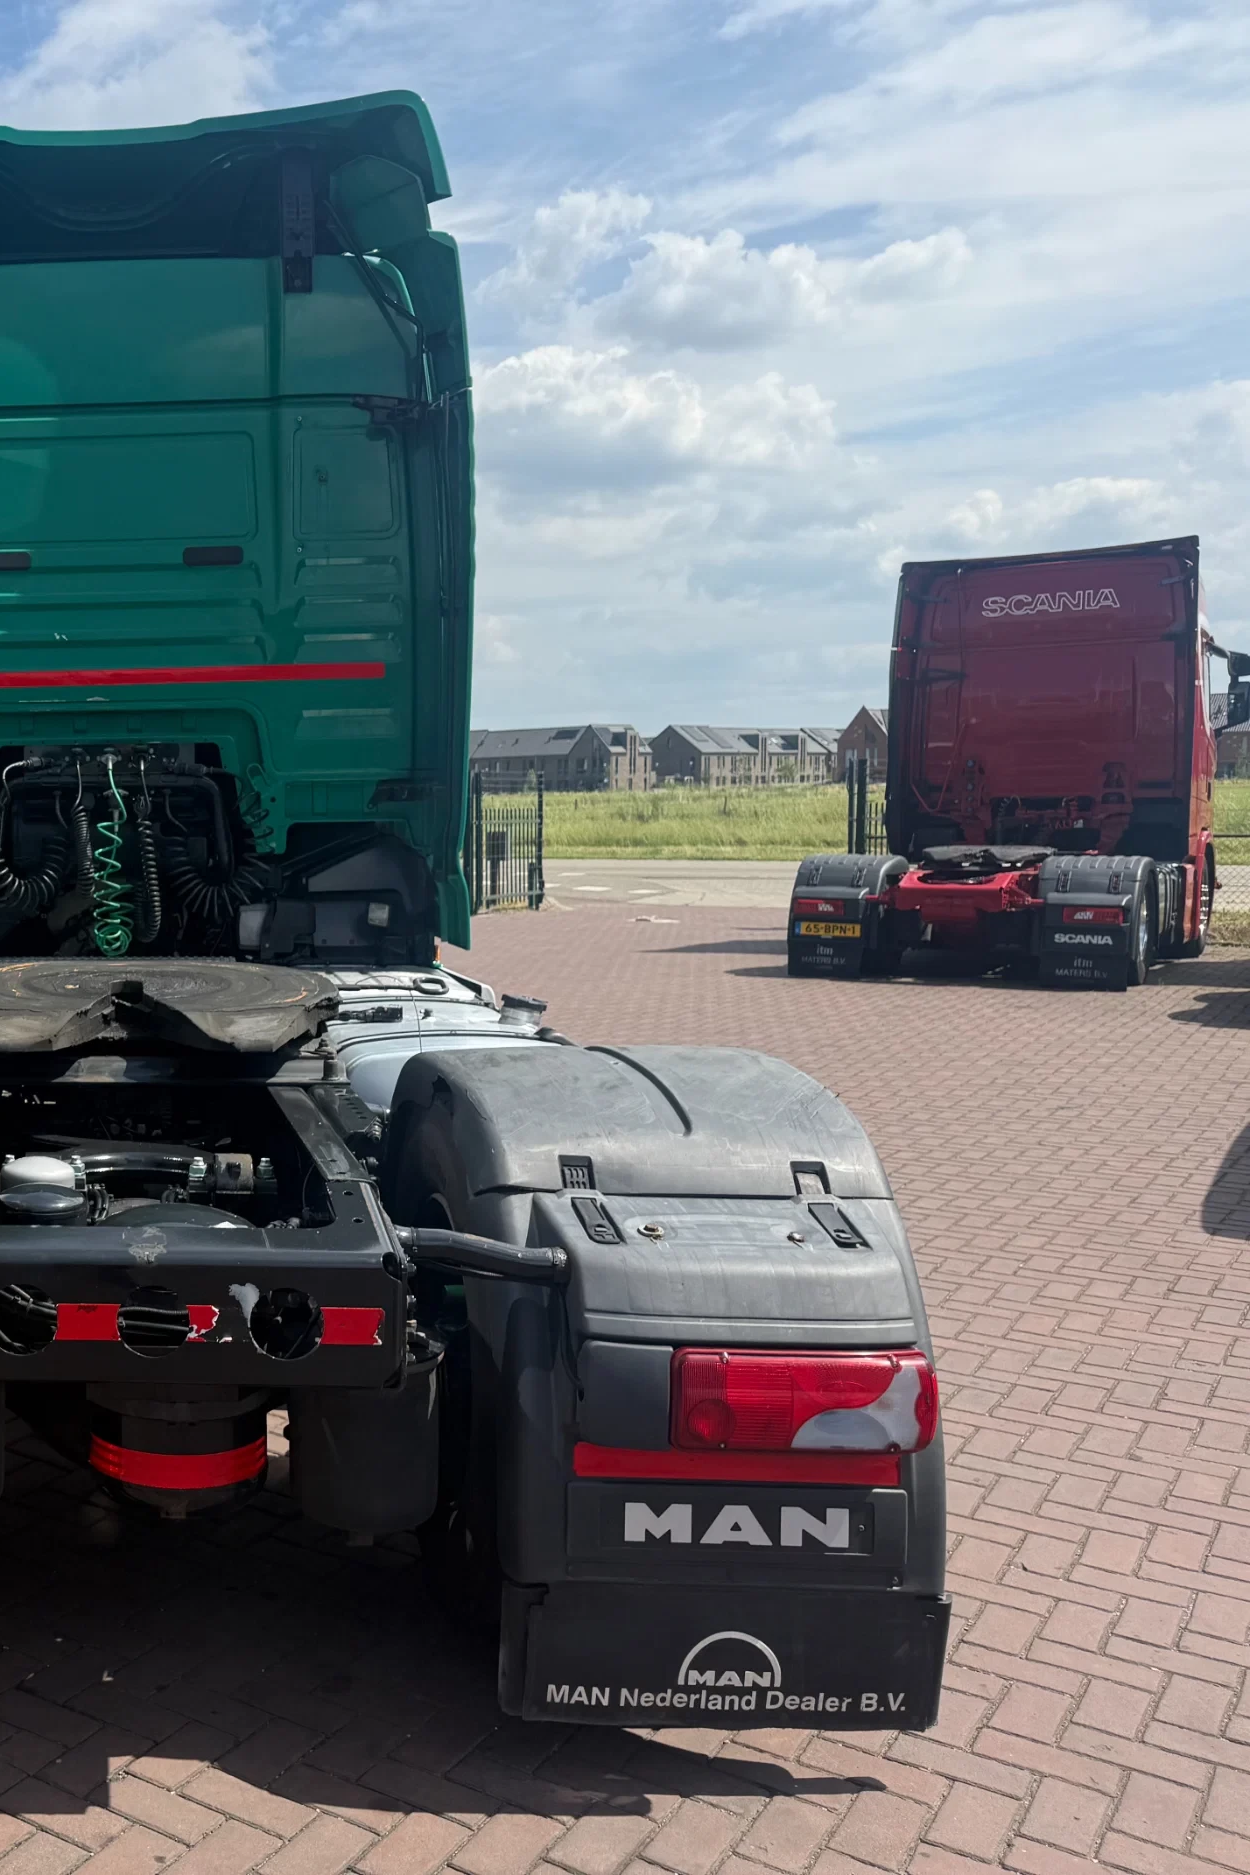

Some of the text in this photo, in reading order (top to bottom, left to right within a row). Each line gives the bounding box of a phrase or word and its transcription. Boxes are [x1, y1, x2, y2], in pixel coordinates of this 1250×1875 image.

[981, 588, 1120, 617] SCANIA
[805, 924, 856, 935] 65-BPN-1
[1054, 933, 1113, 945] SCANIA
[624, 1502, 850, 1548] MAN
[688, 1669, 772, 1688] MAN
[546, 1684, 907, 1712] MAN Nederland Dealer B.V.
